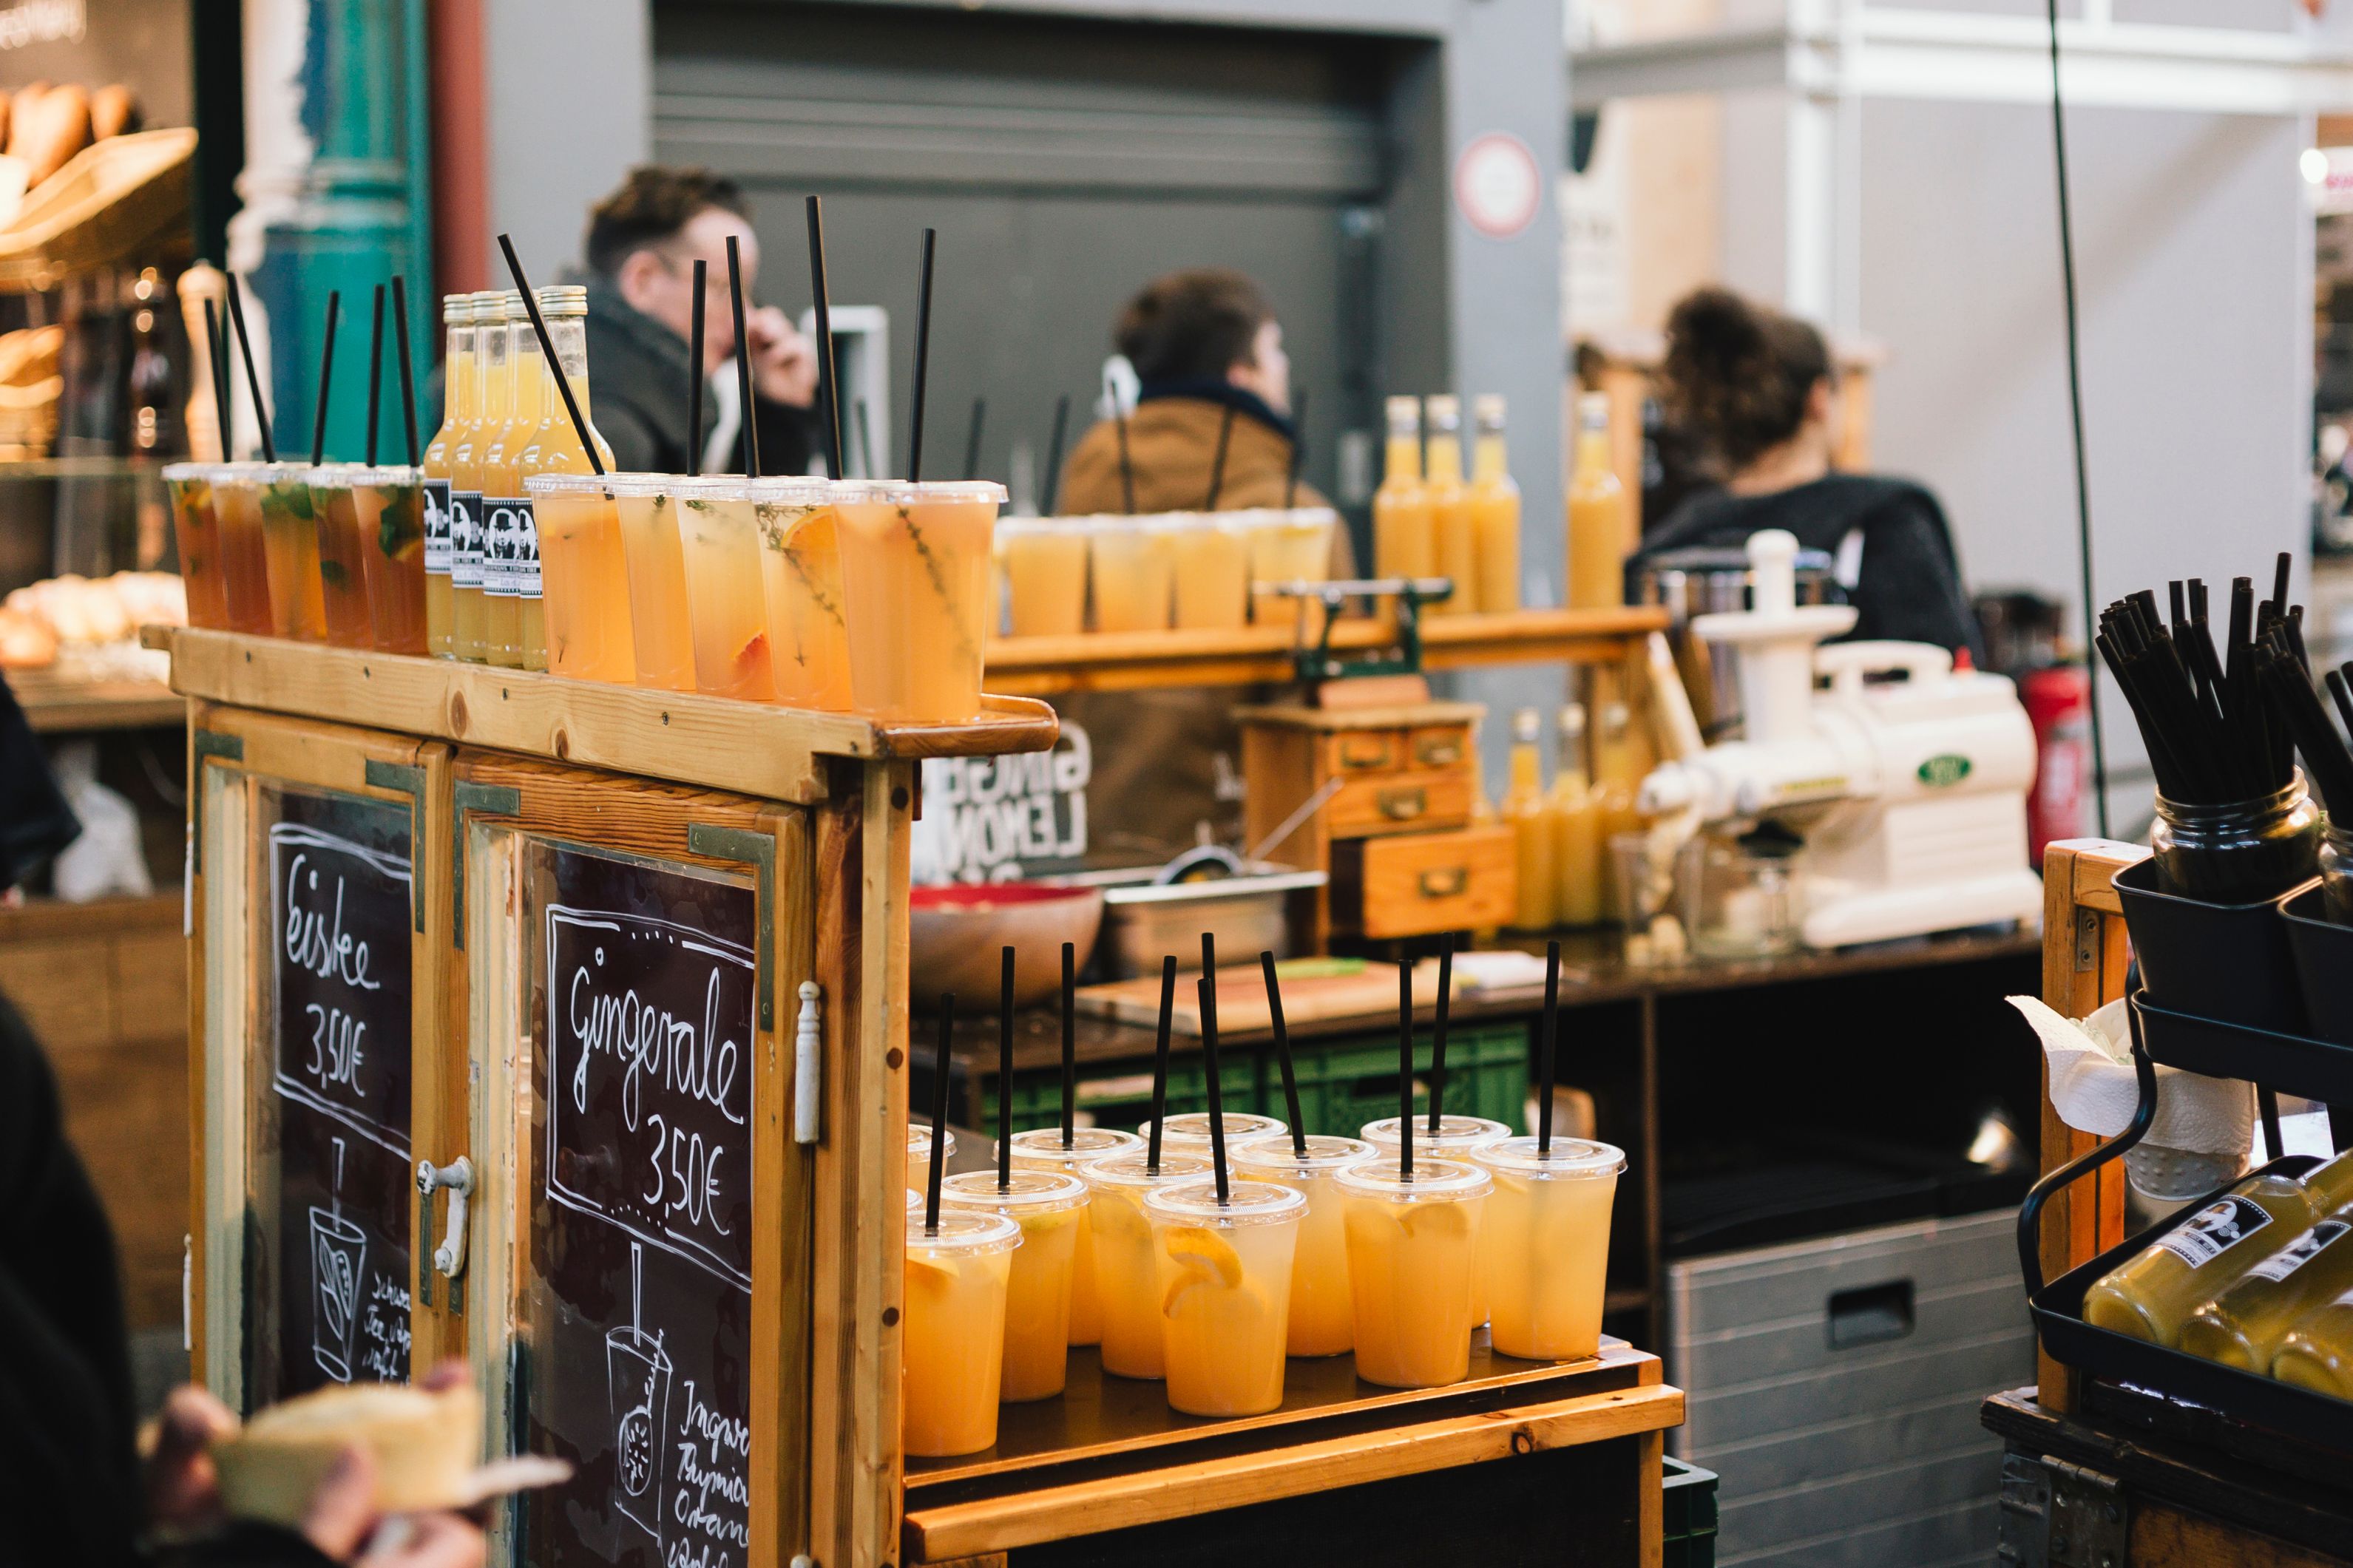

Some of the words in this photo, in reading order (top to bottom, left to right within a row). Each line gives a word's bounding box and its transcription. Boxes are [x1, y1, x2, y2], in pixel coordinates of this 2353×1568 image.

[305, 1002, 367, 1098] 3,50€
[570, 947, 744, 1133] Gingerale
[643, 1113, 731, 1236] 3,50€
[674, 1488, 749, 1548] Oran
